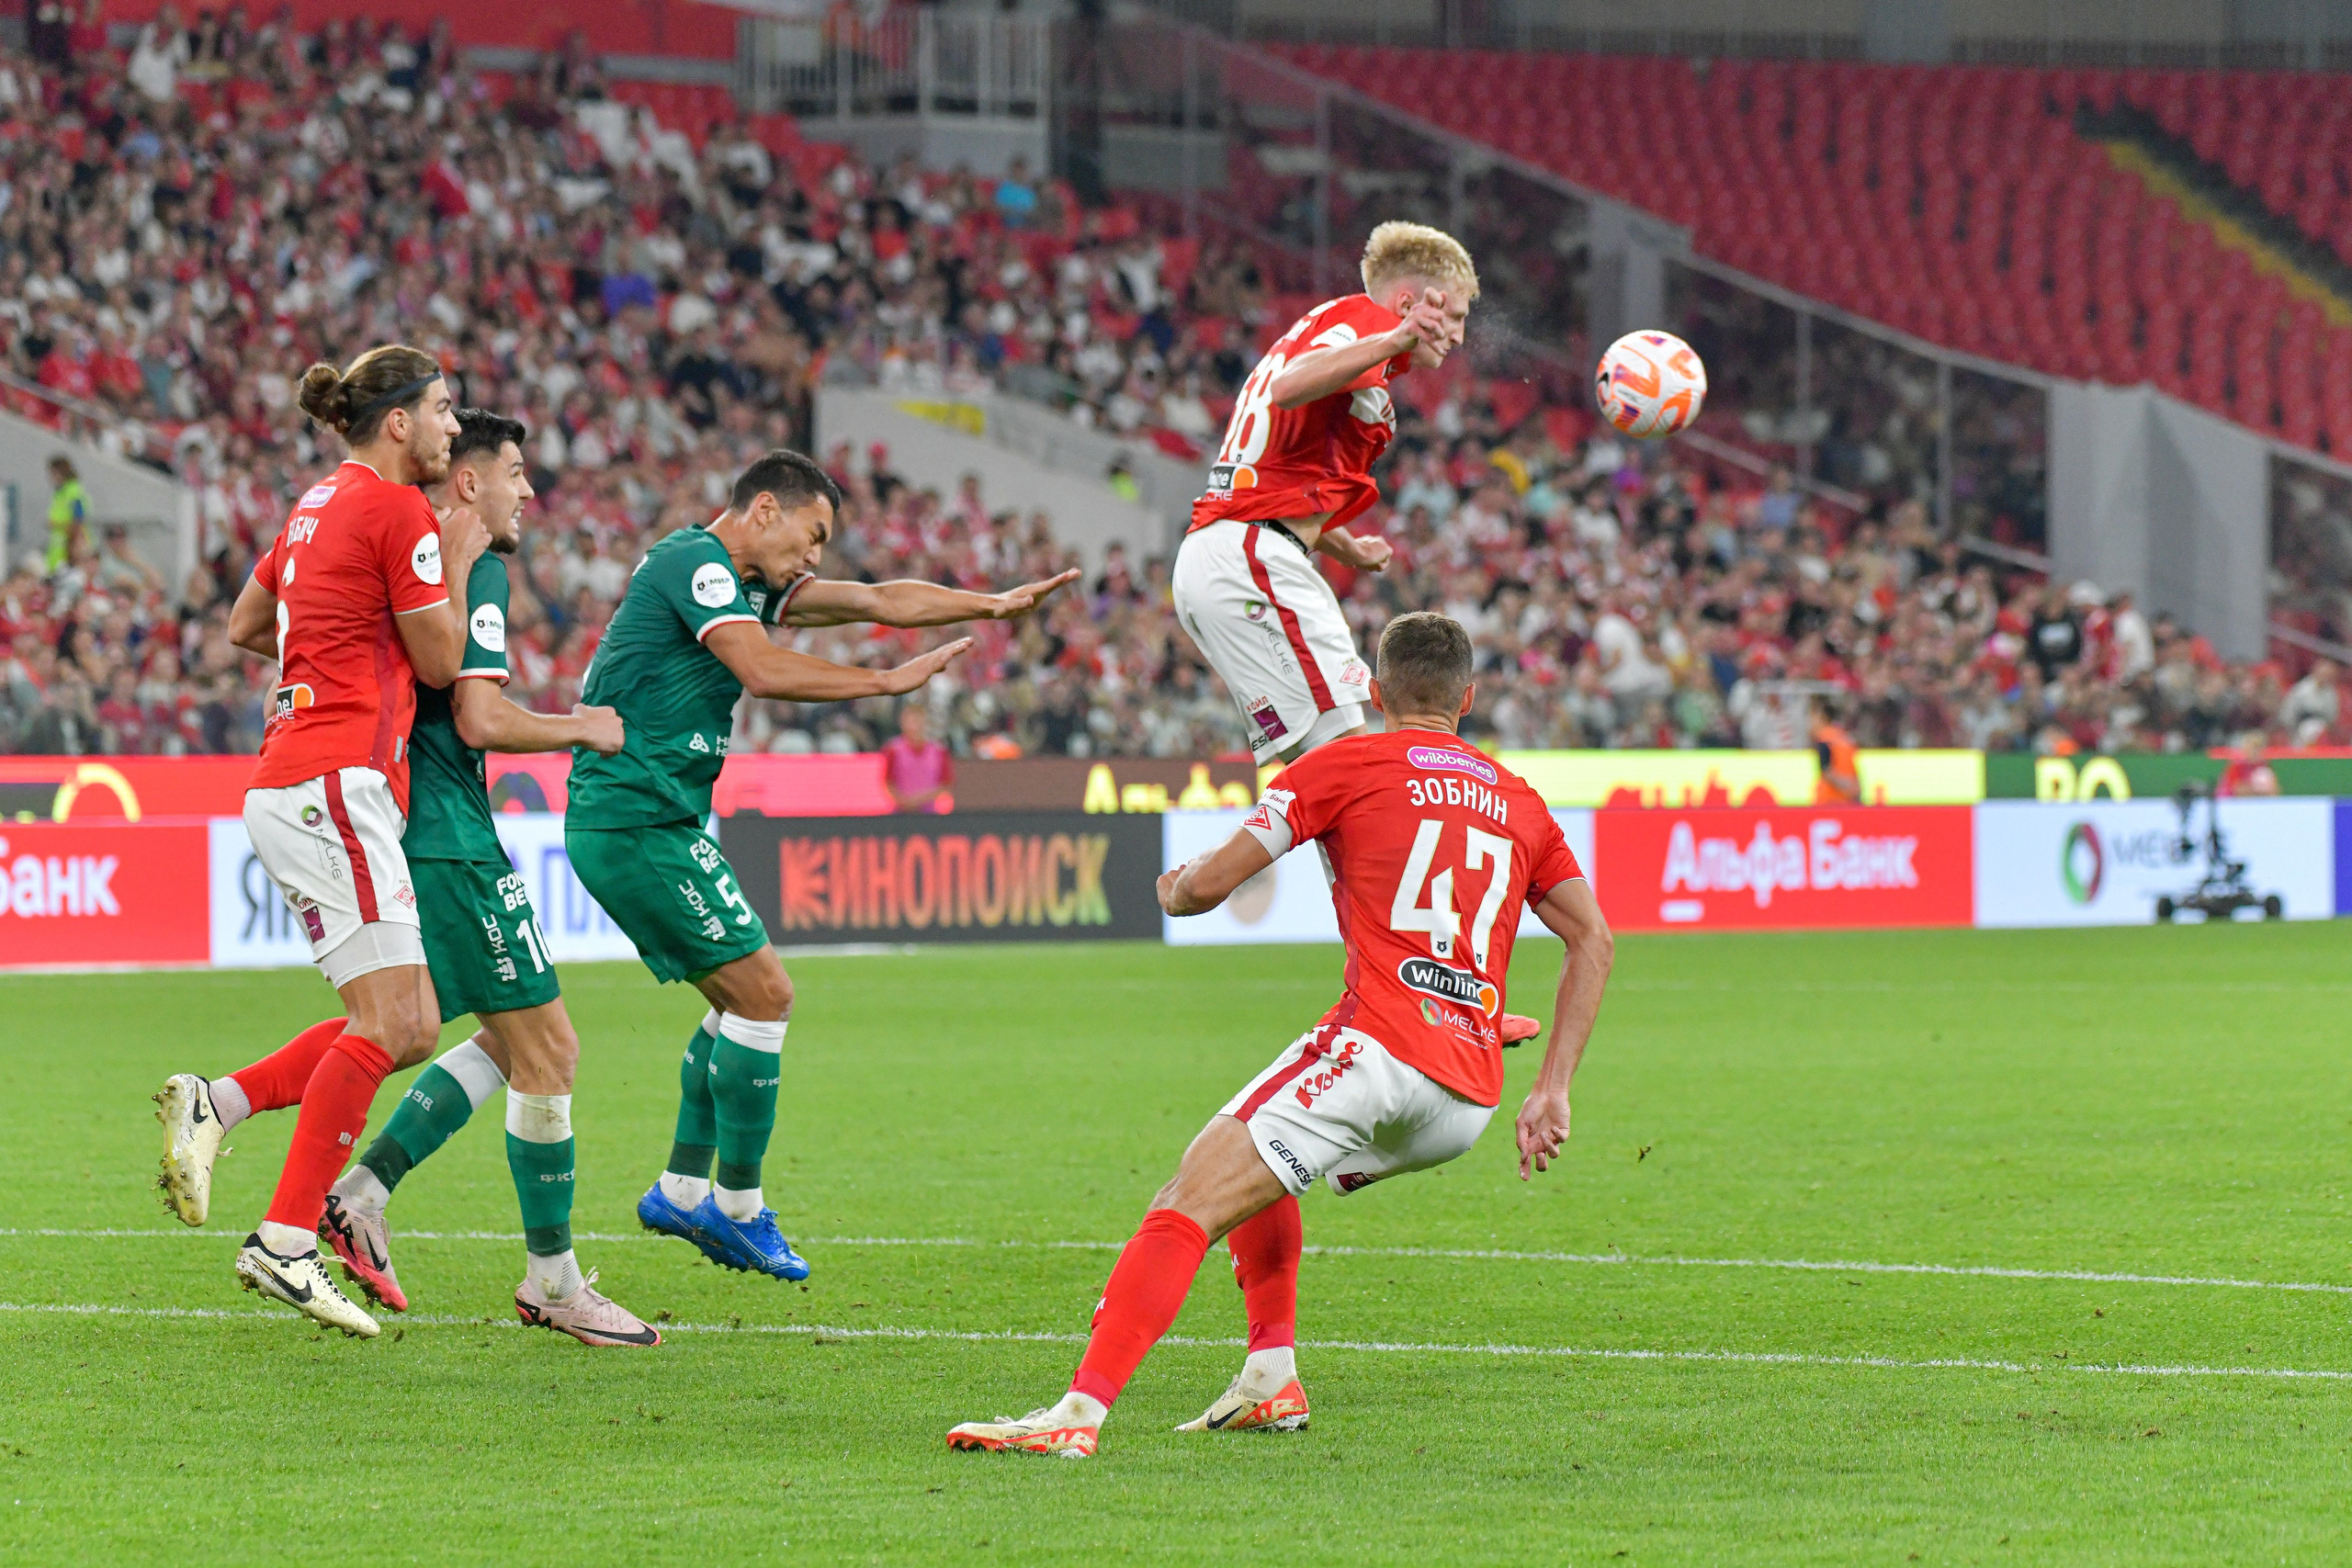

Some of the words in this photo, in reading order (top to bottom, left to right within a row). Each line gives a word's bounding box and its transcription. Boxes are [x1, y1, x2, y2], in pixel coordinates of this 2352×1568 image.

[1415, 752, 1493, 779] wildberries
[1407, 777, 1508, 826] ЗОБНИН
[779, 833, 1112, 931] КИНОПОИСК
[1660, 819, 1806, 908] Альфа
[1809, 818, 1919, 890] Банк
[715, 874, 752, 926] 5
[1390, 818, 1513, 973] 47
[1411, 964, 1480, 999] Winlin
[1444, 1010, 1496, 1043] MELKE
